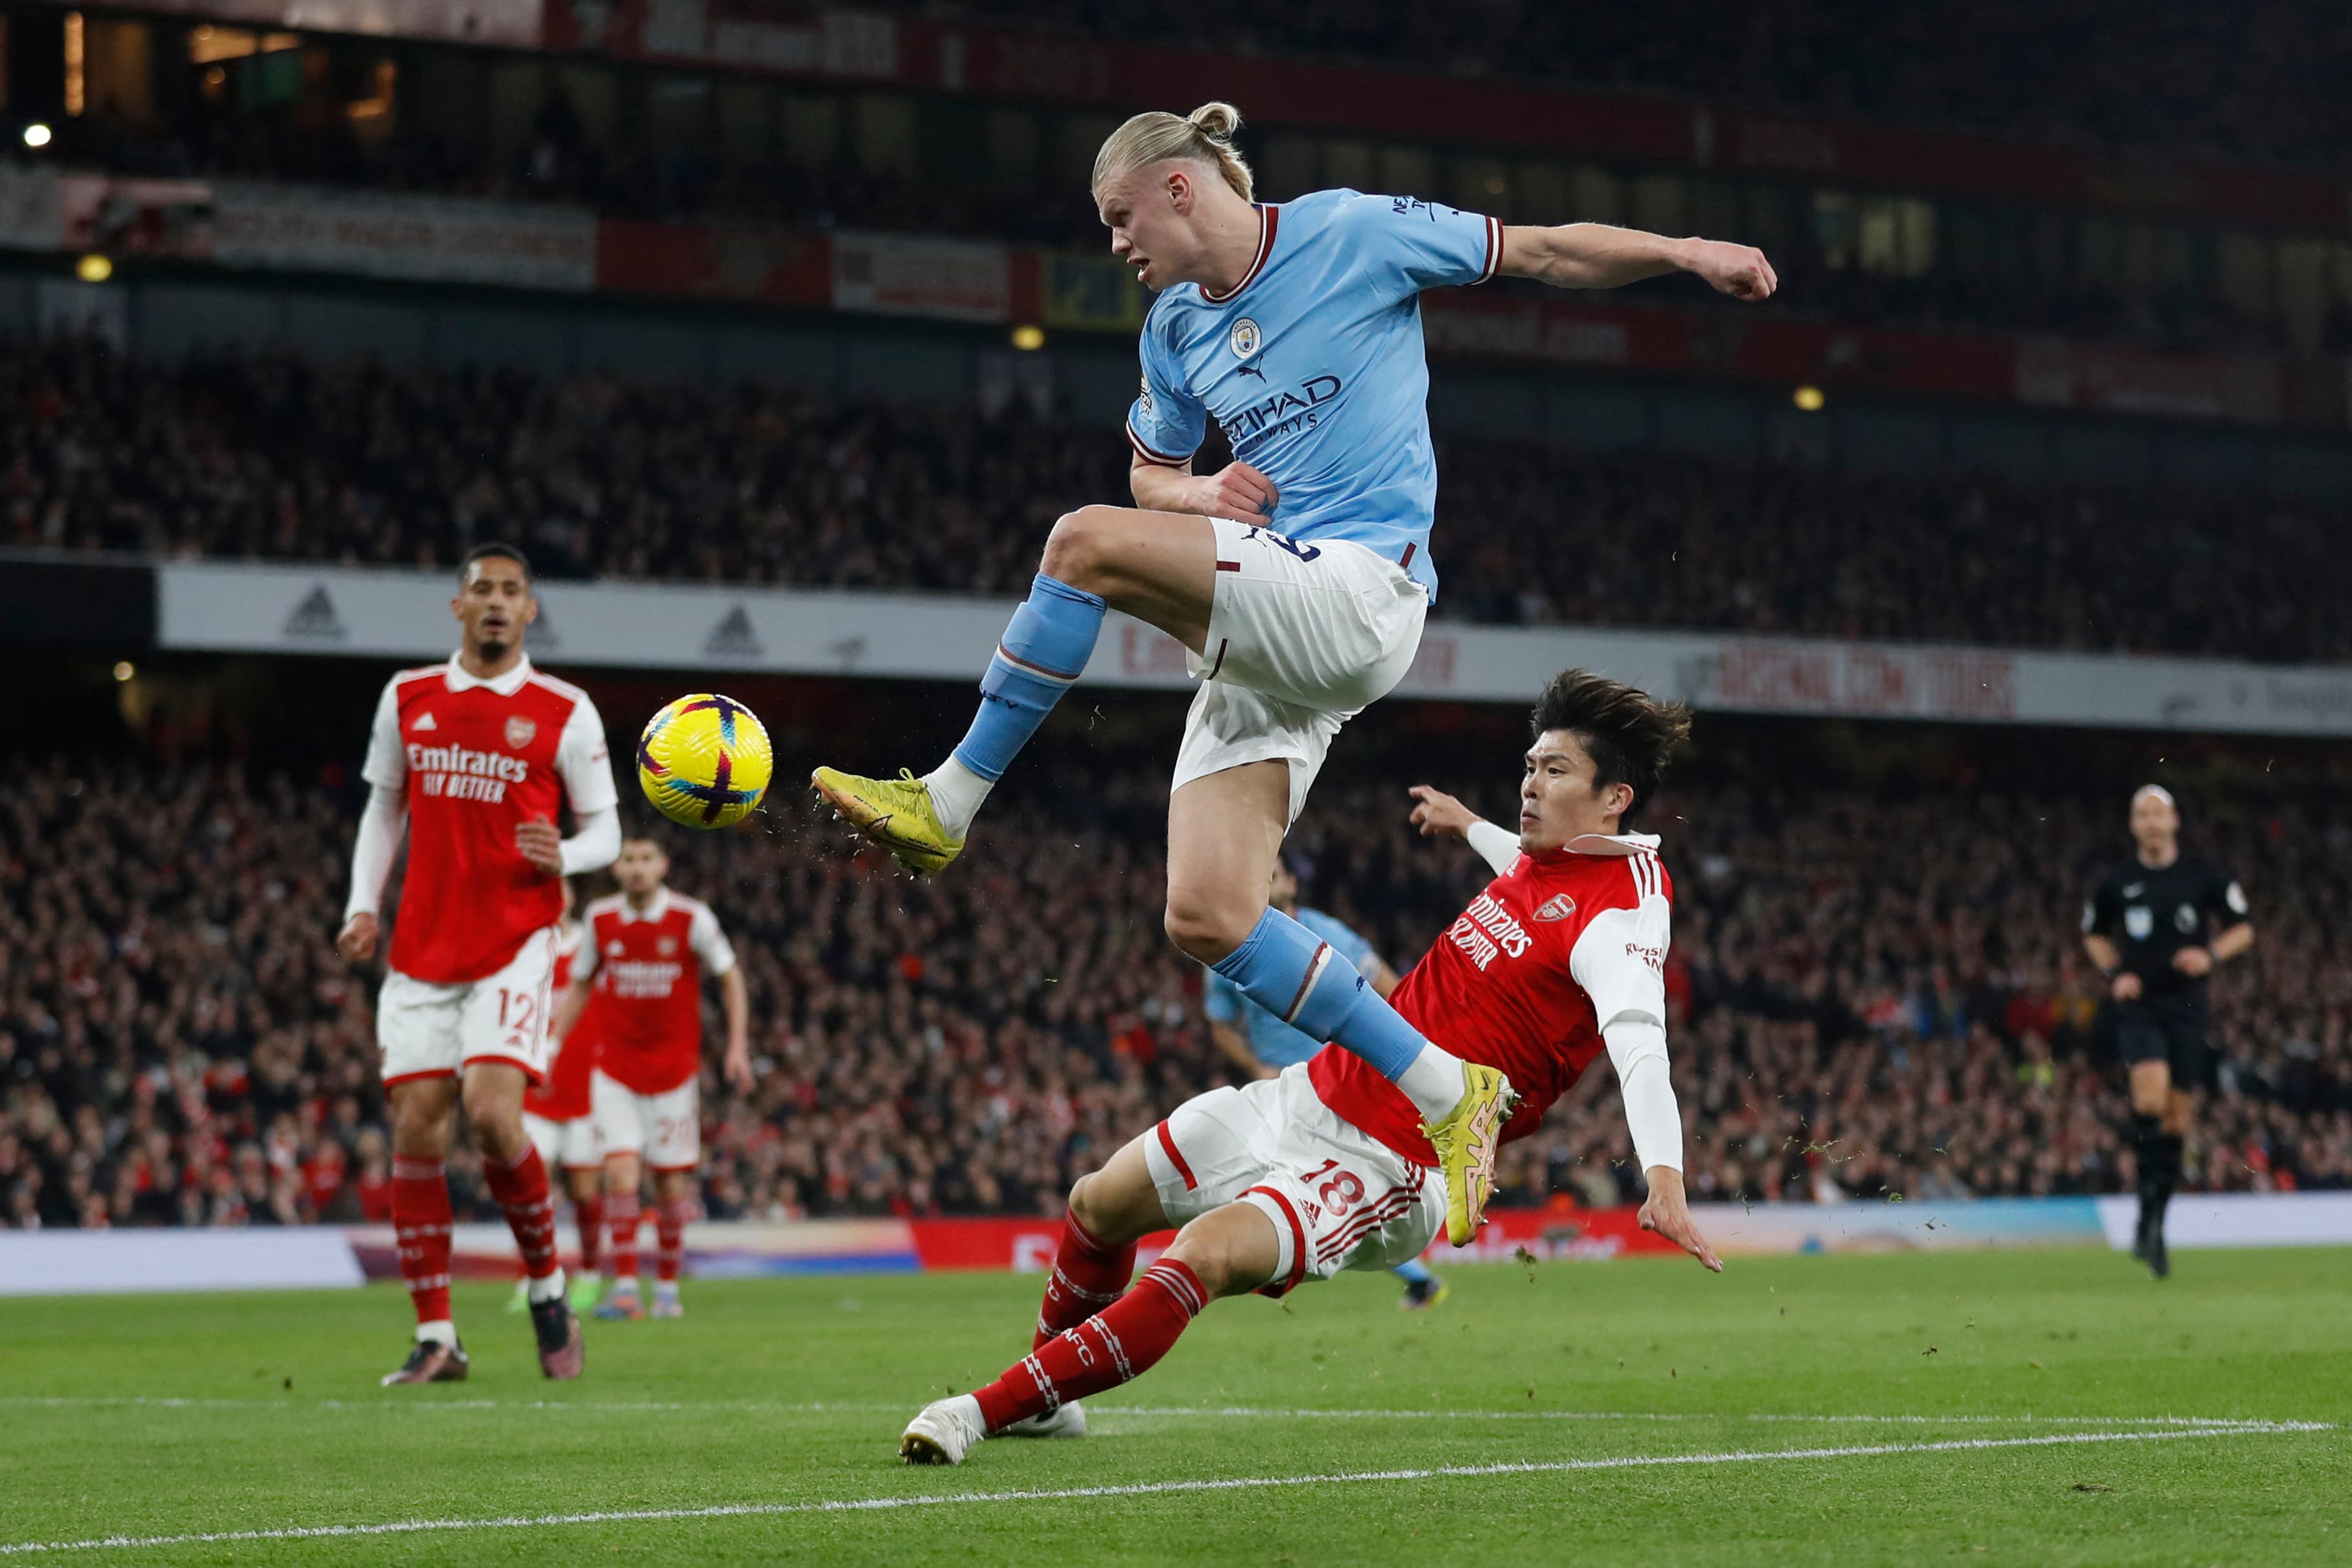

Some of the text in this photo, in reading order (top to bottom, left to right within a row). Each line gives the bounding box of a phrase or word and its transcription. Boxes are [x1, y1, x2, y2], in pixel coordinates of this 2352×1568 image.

[407, 743, 528, 783] Emirates
[445, 773, 506, 804] BETTER
[1466, 887, 1533, 959] mirates
[498, 988, 535, 1033] 12
[1299, 1158, 1365, 1216] 18
[1061, 1328, 1095, 1367] AFC
